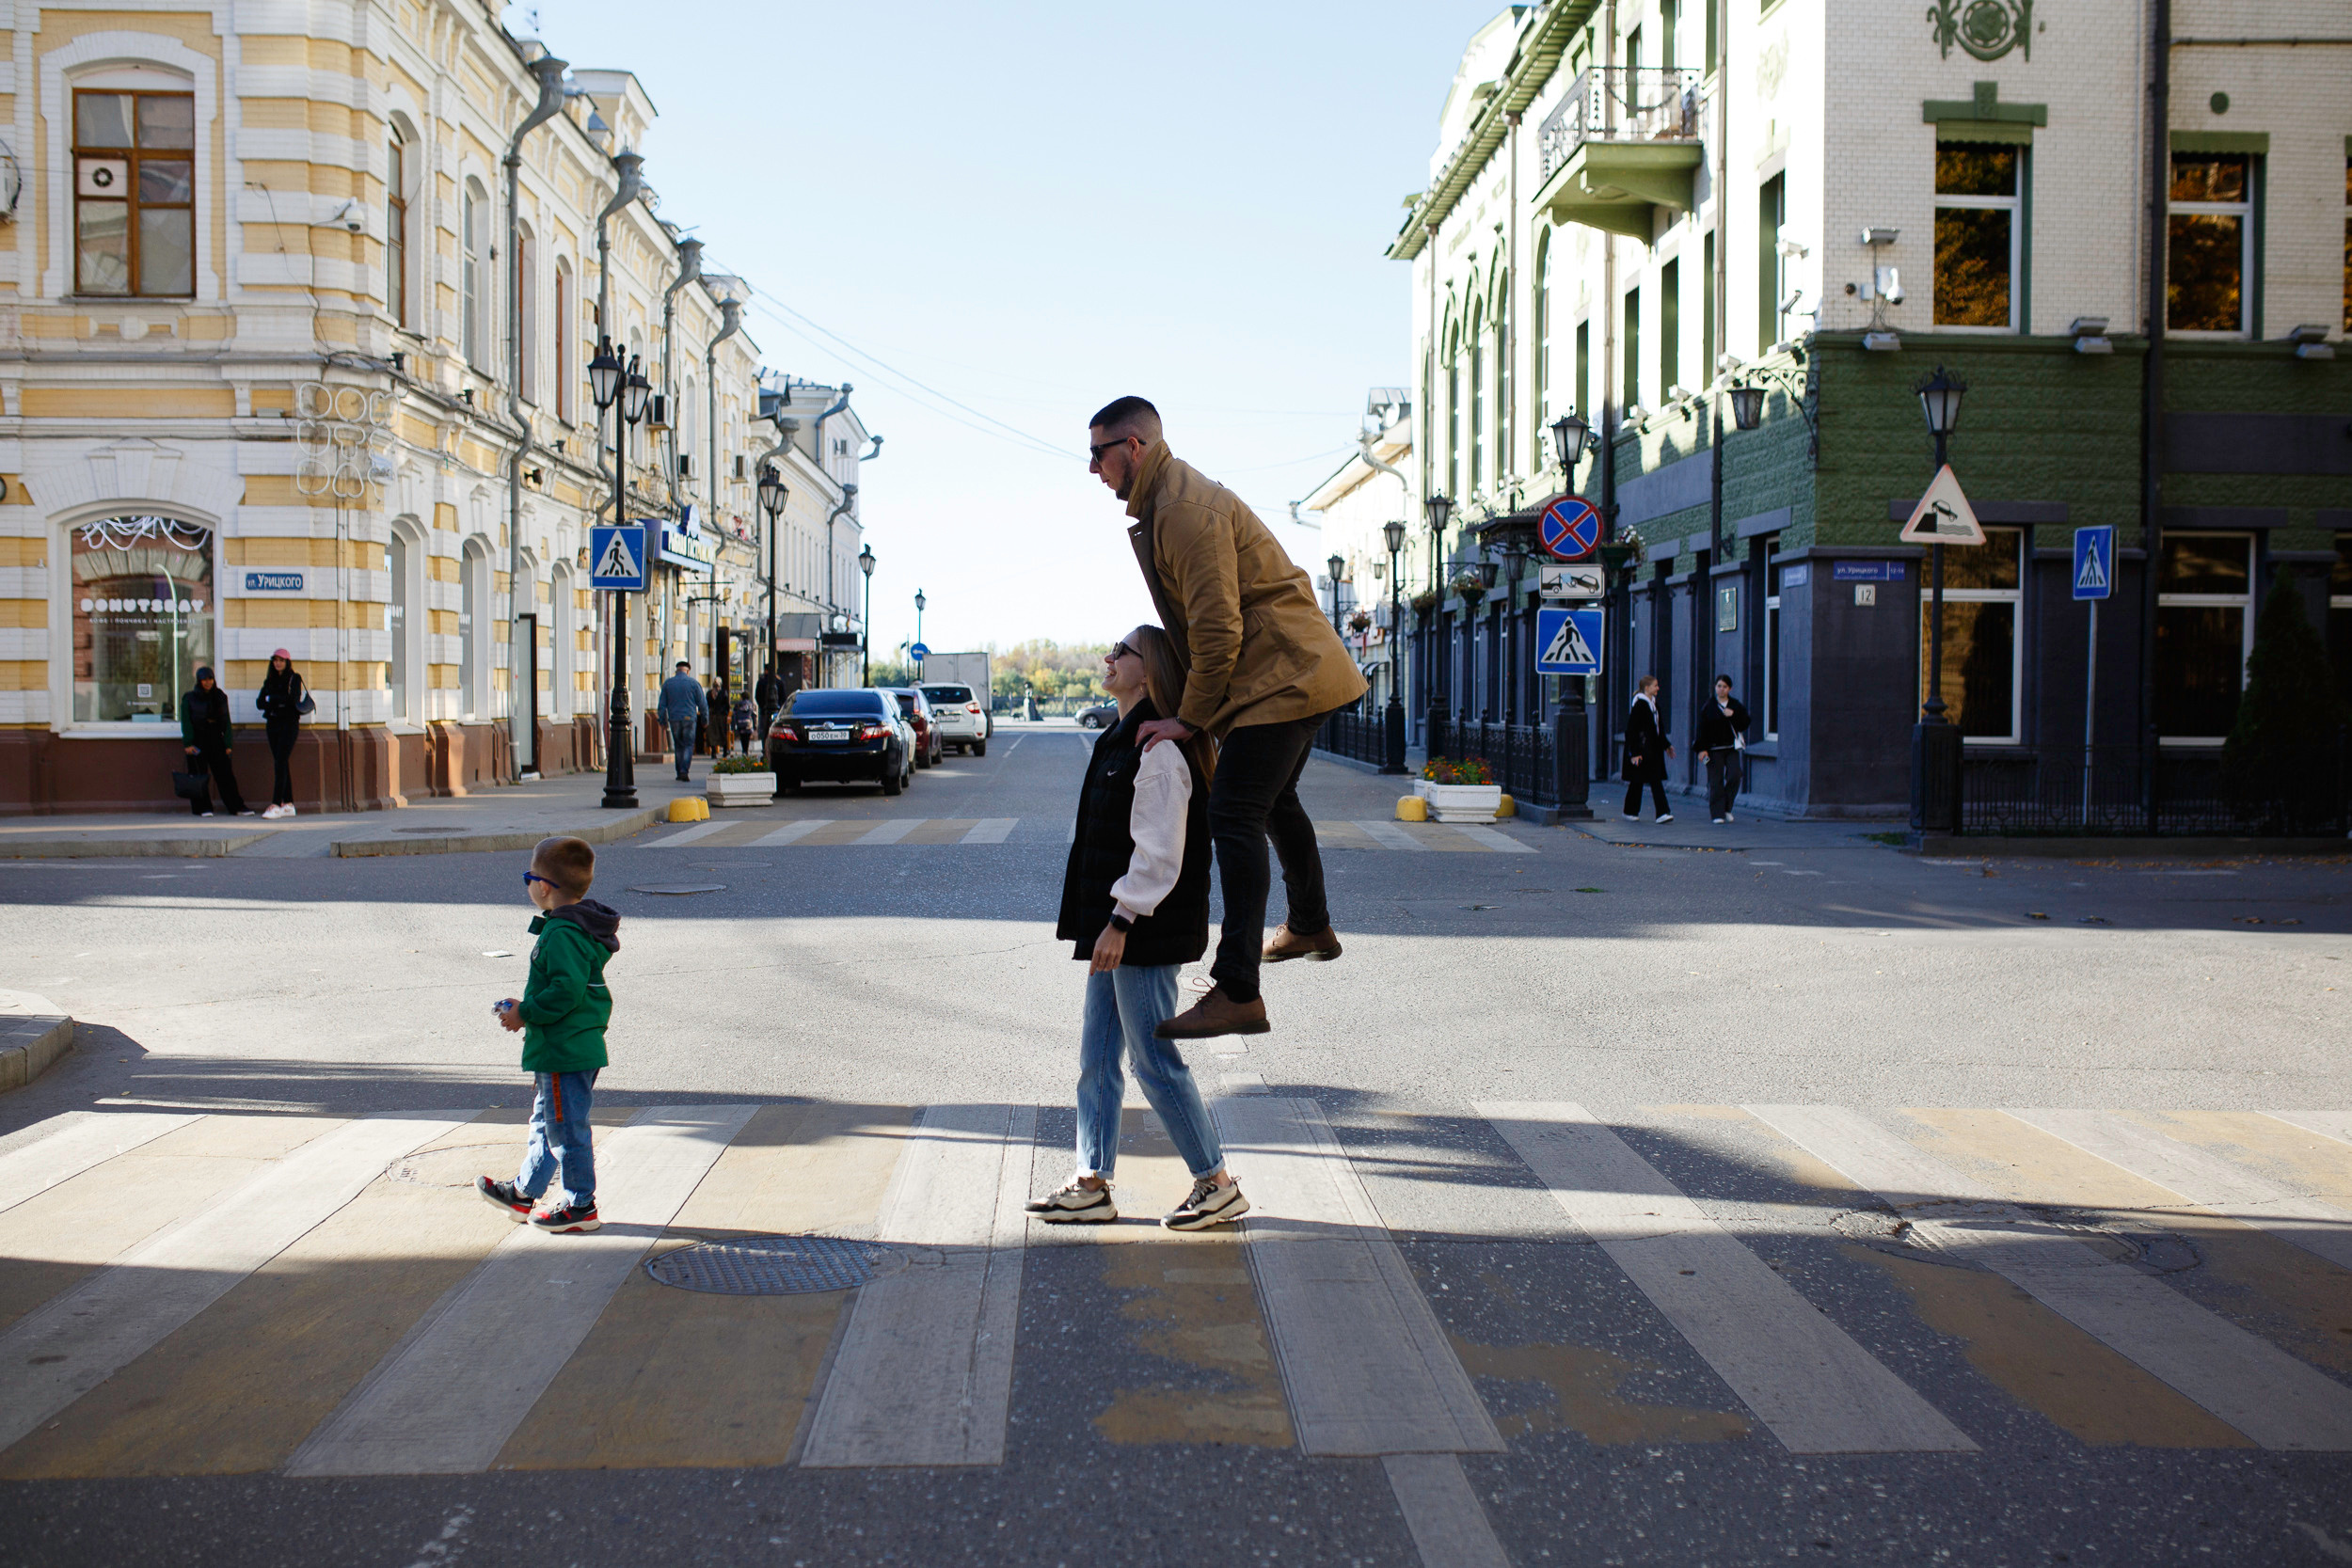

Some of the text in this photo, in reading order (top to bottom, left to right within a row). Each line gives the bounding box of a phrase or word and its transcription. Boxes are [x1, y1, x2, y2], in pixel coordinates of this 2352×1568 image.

[1848, 566, 1879, 576] Урицкого
[1860, 589, 1872, 602] 12
[80, 598, 204, 612] DONUTSDAY
